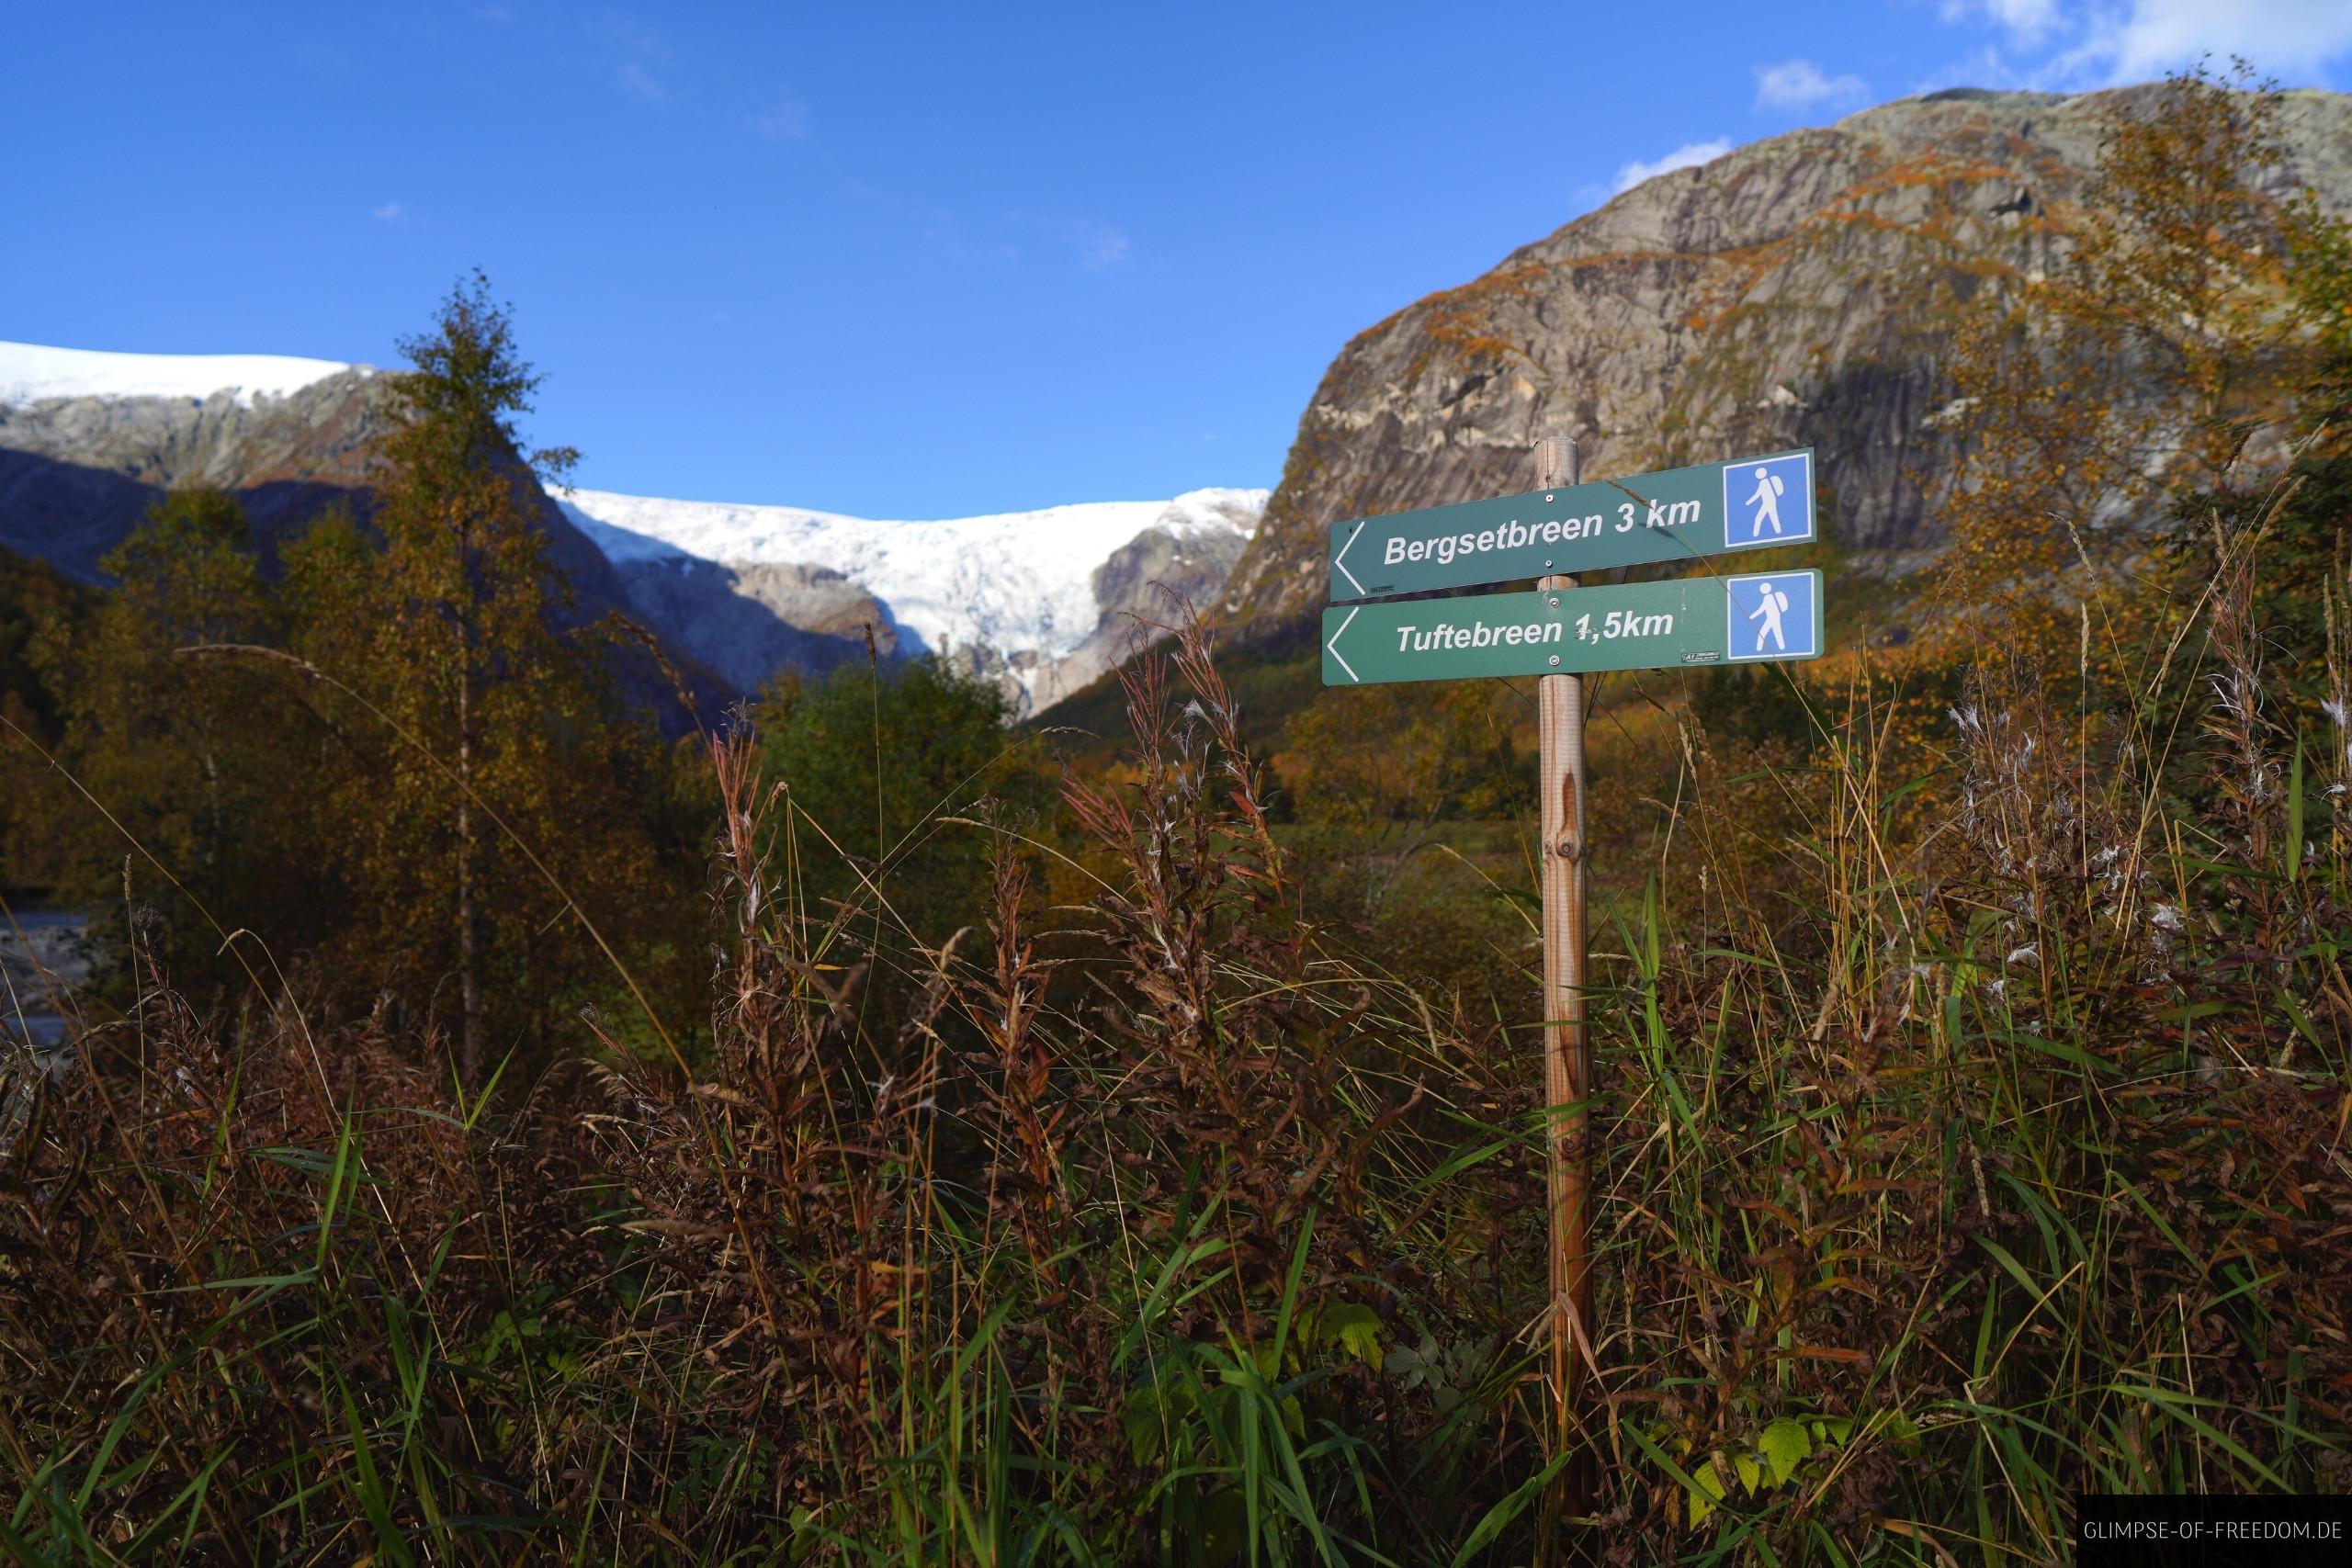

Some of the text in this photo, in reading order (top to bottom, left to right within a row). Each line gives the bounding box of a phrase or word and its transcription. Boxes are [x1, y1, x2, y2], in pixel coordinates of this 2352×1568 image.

[1384, 498, 1702, 565] Bergsetbreen 3 km
[1396, 610, 1673, 651] Tuftebreen 1,5km
